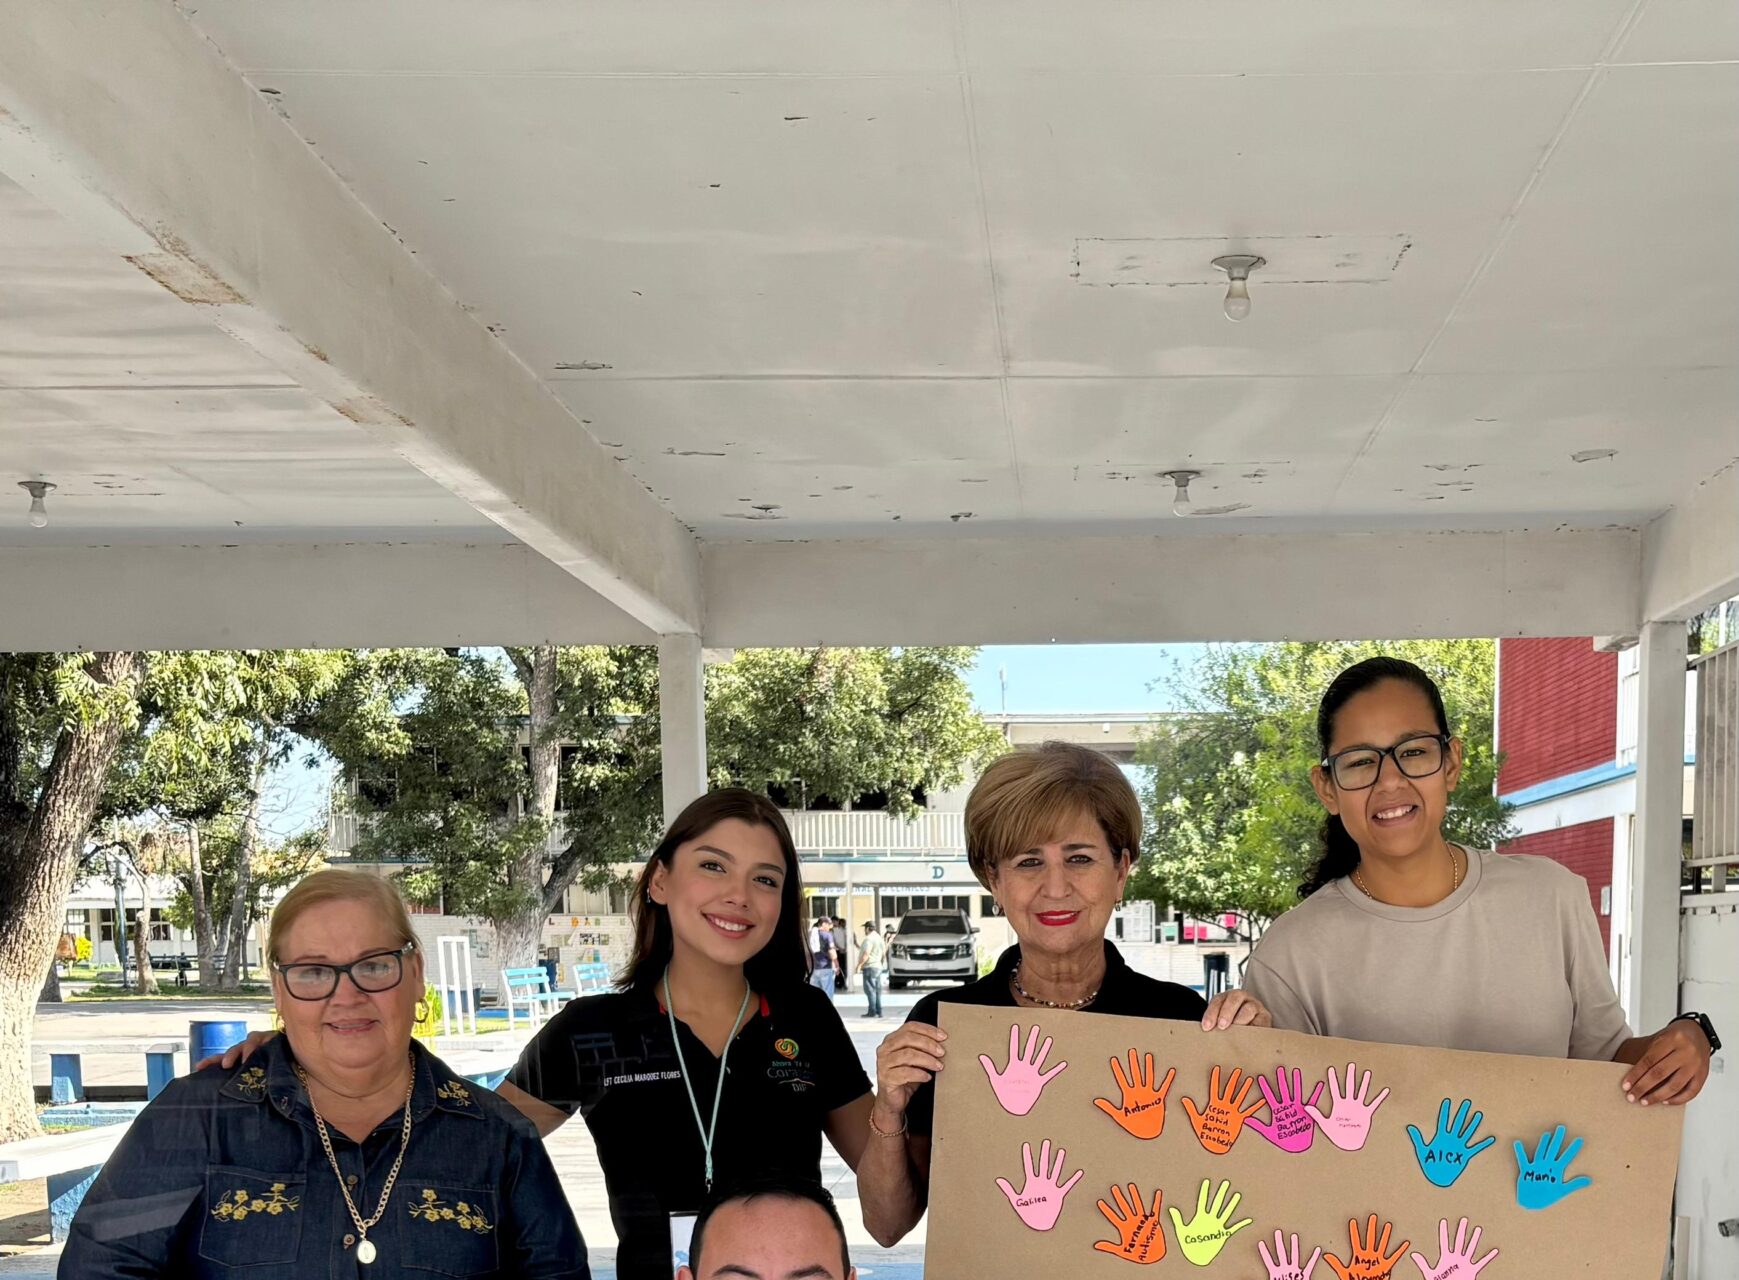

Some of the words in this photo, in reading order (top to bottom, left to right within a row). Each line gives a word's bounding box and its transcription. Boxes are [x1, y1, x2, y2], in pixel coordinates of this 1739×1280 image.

[932, 866, 945, 879] D
[613, 1074, 633, 1084] CECILIA
[634, 1072, 659, 1082] MARQUEZ
[660, 1070, 681, 1079] FLORES
[1124, 1098, 1162, 1117] Antonio
[1424, 1149, 1463, 1166] Alex
